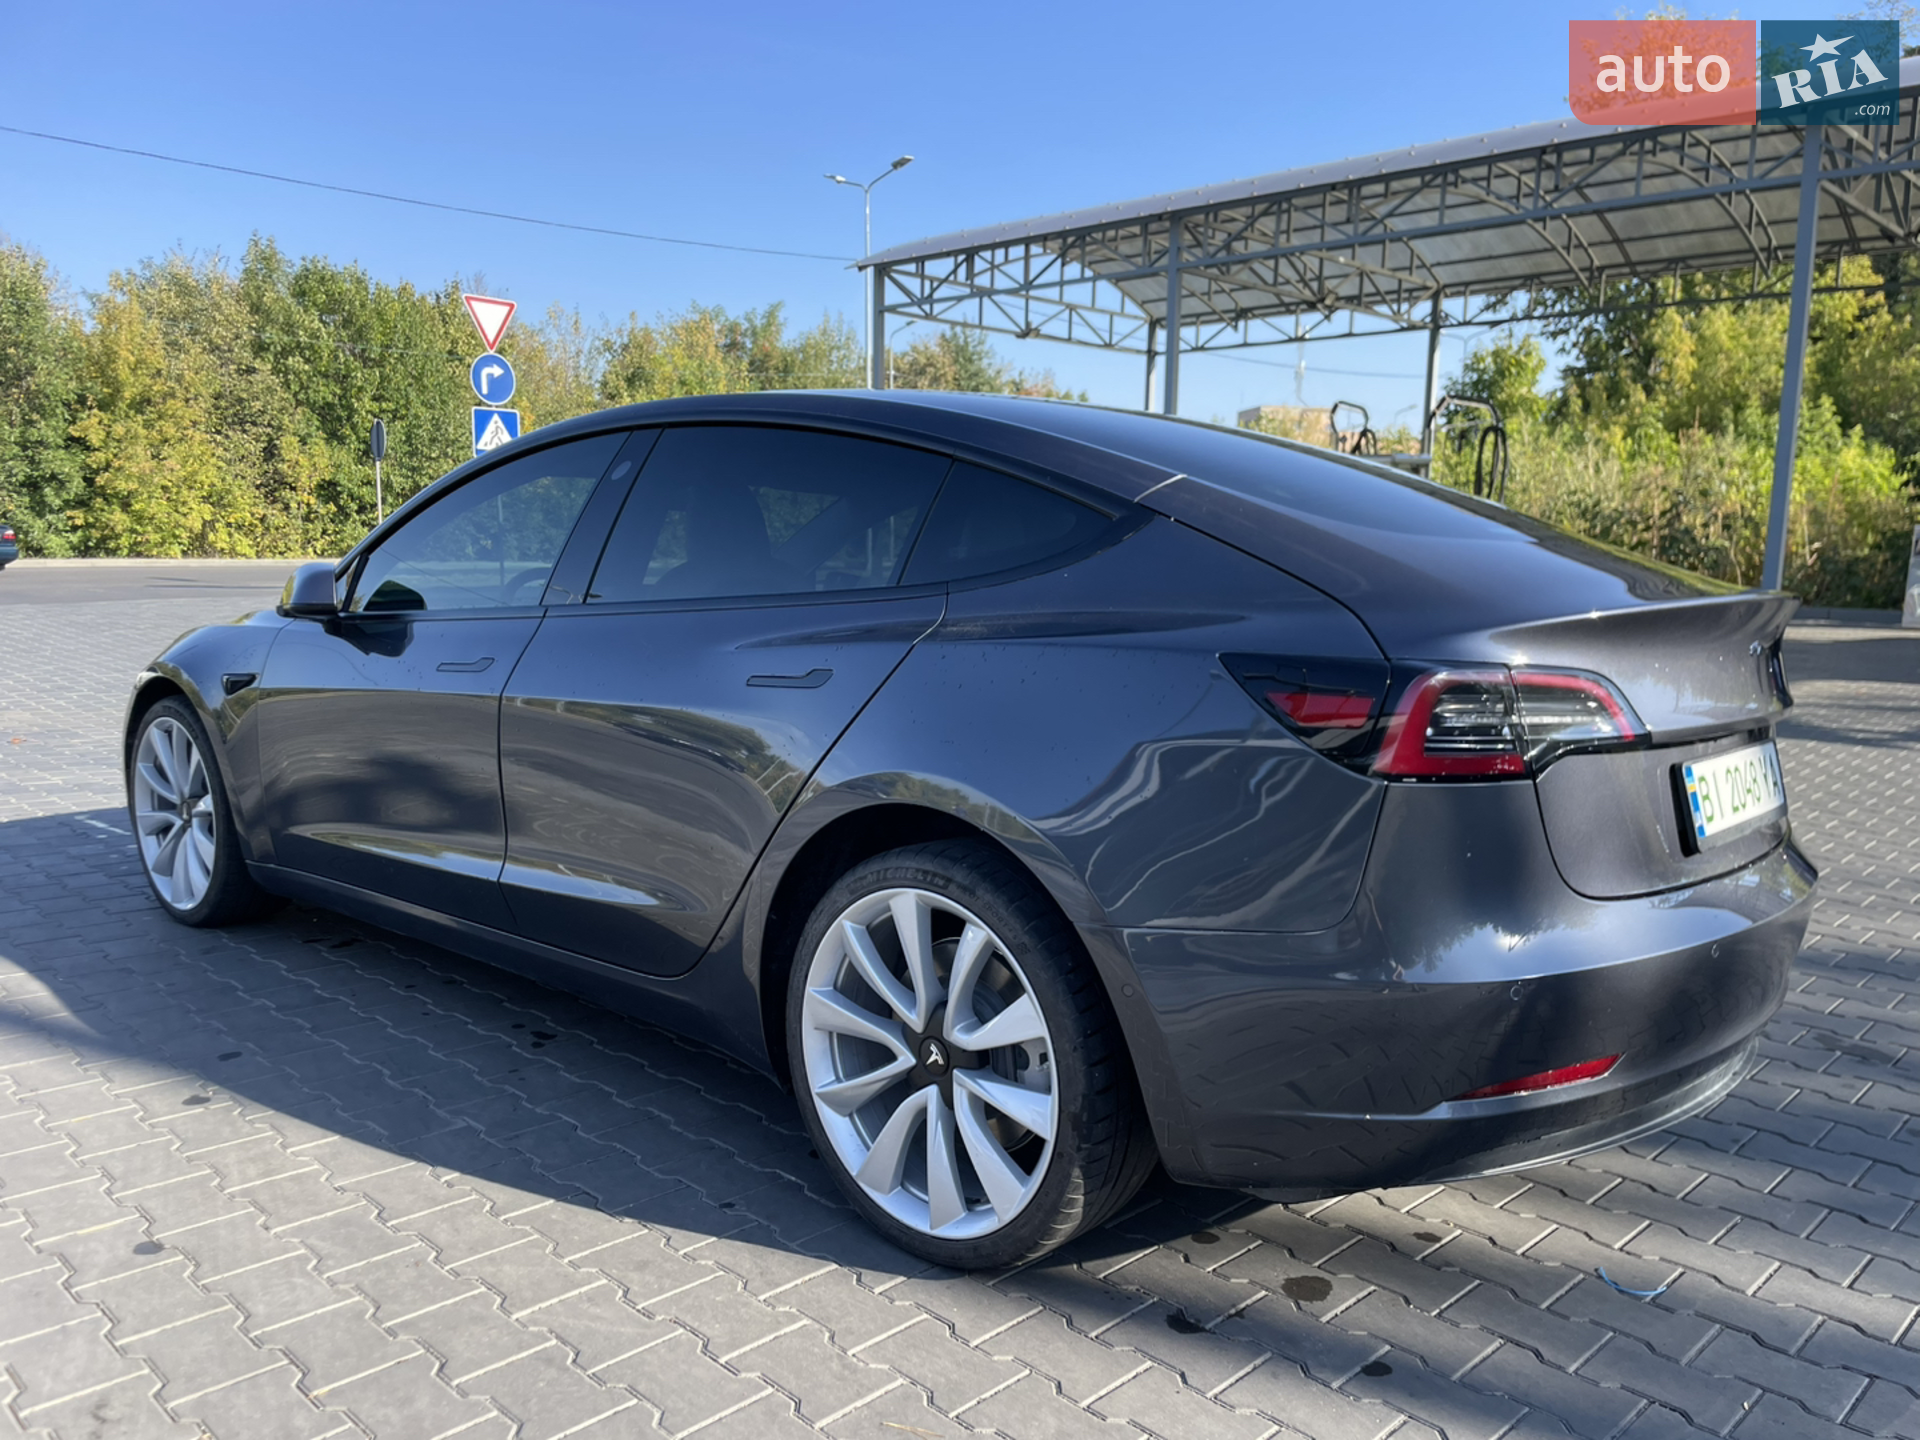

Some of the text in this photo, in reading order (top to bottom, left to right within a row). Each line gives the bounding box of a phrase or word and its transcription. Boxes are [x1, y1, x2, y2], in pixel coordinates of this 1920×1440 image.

[1697, 771, 1724, 823] BI
[1725, 760, 1761, 813] 2048
[863, 868, 945, 886] MICHELIN
